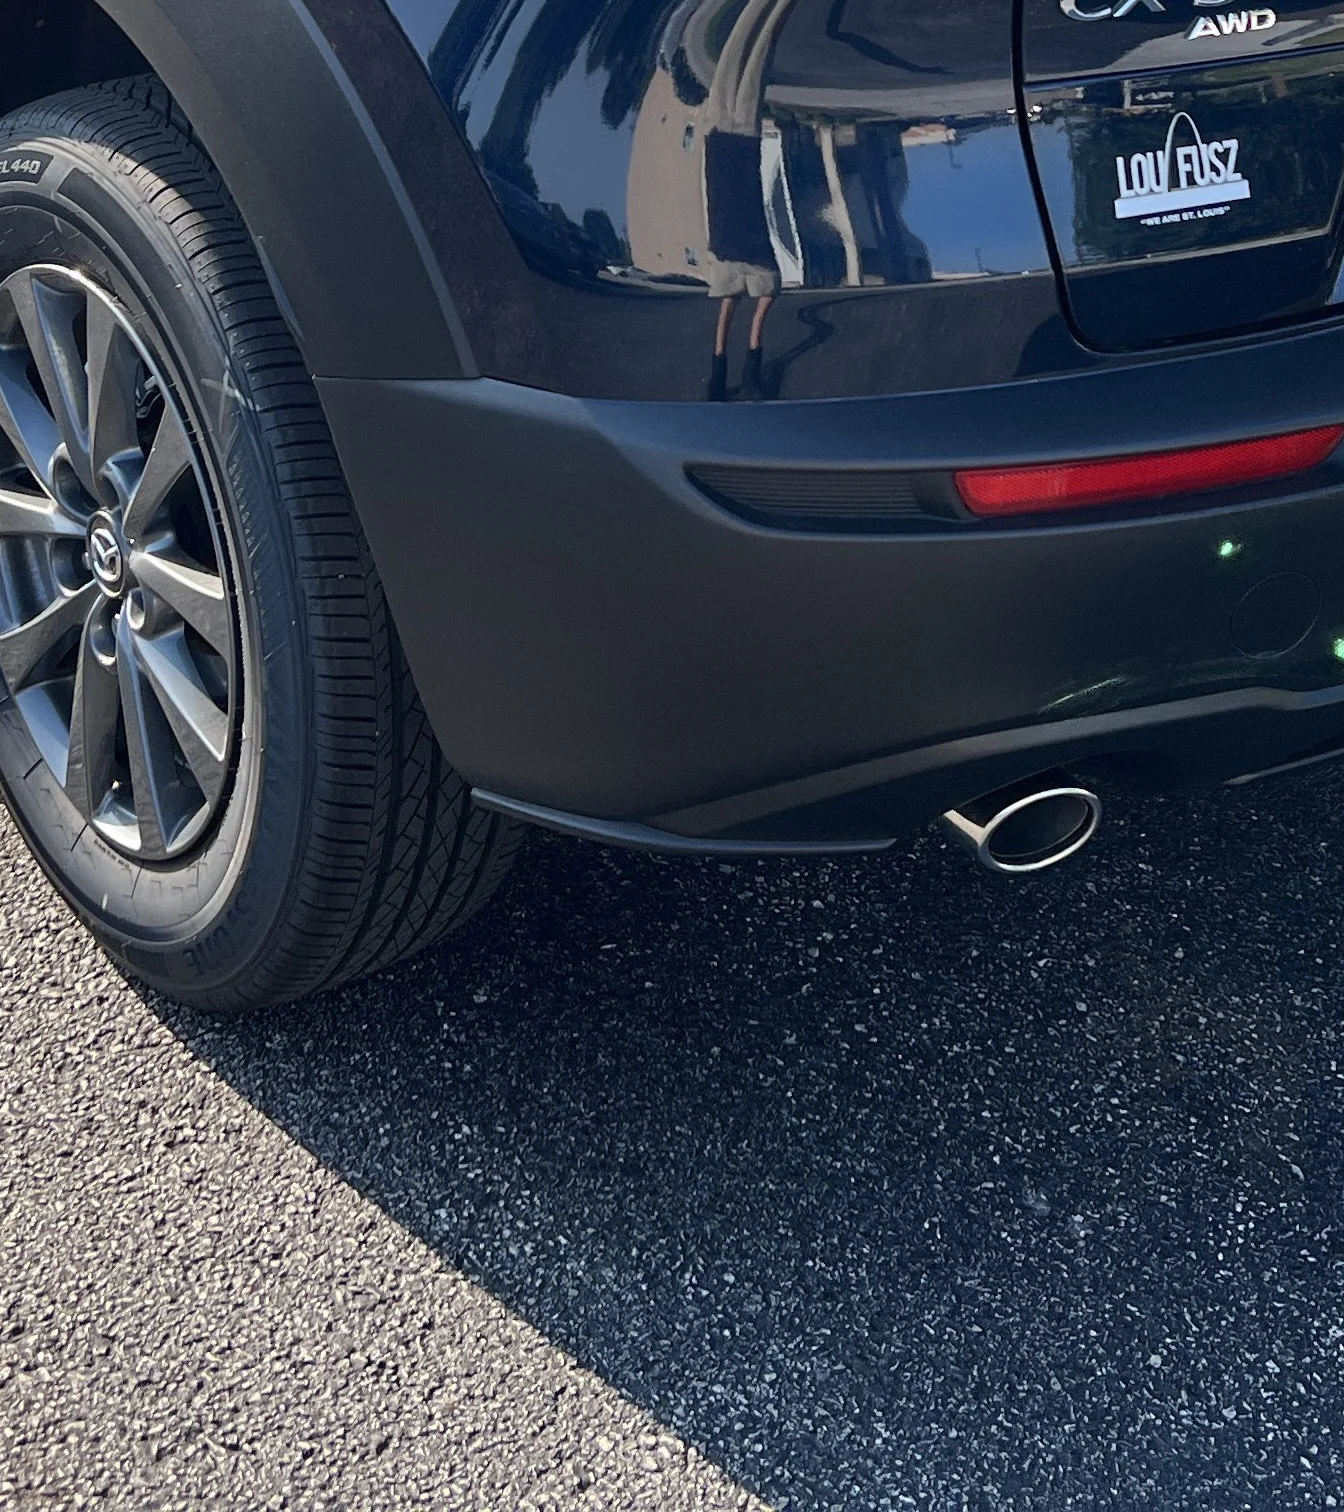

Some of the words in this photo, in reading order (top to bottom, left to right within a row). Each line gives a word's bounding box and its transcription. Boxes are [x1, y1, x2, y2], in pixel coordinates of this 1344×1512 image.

[1186, 8, 1278, 41] AWD
[1115, 149, 1169, 199] LOU
[1175, 138, 1244, 190] FUSZ
